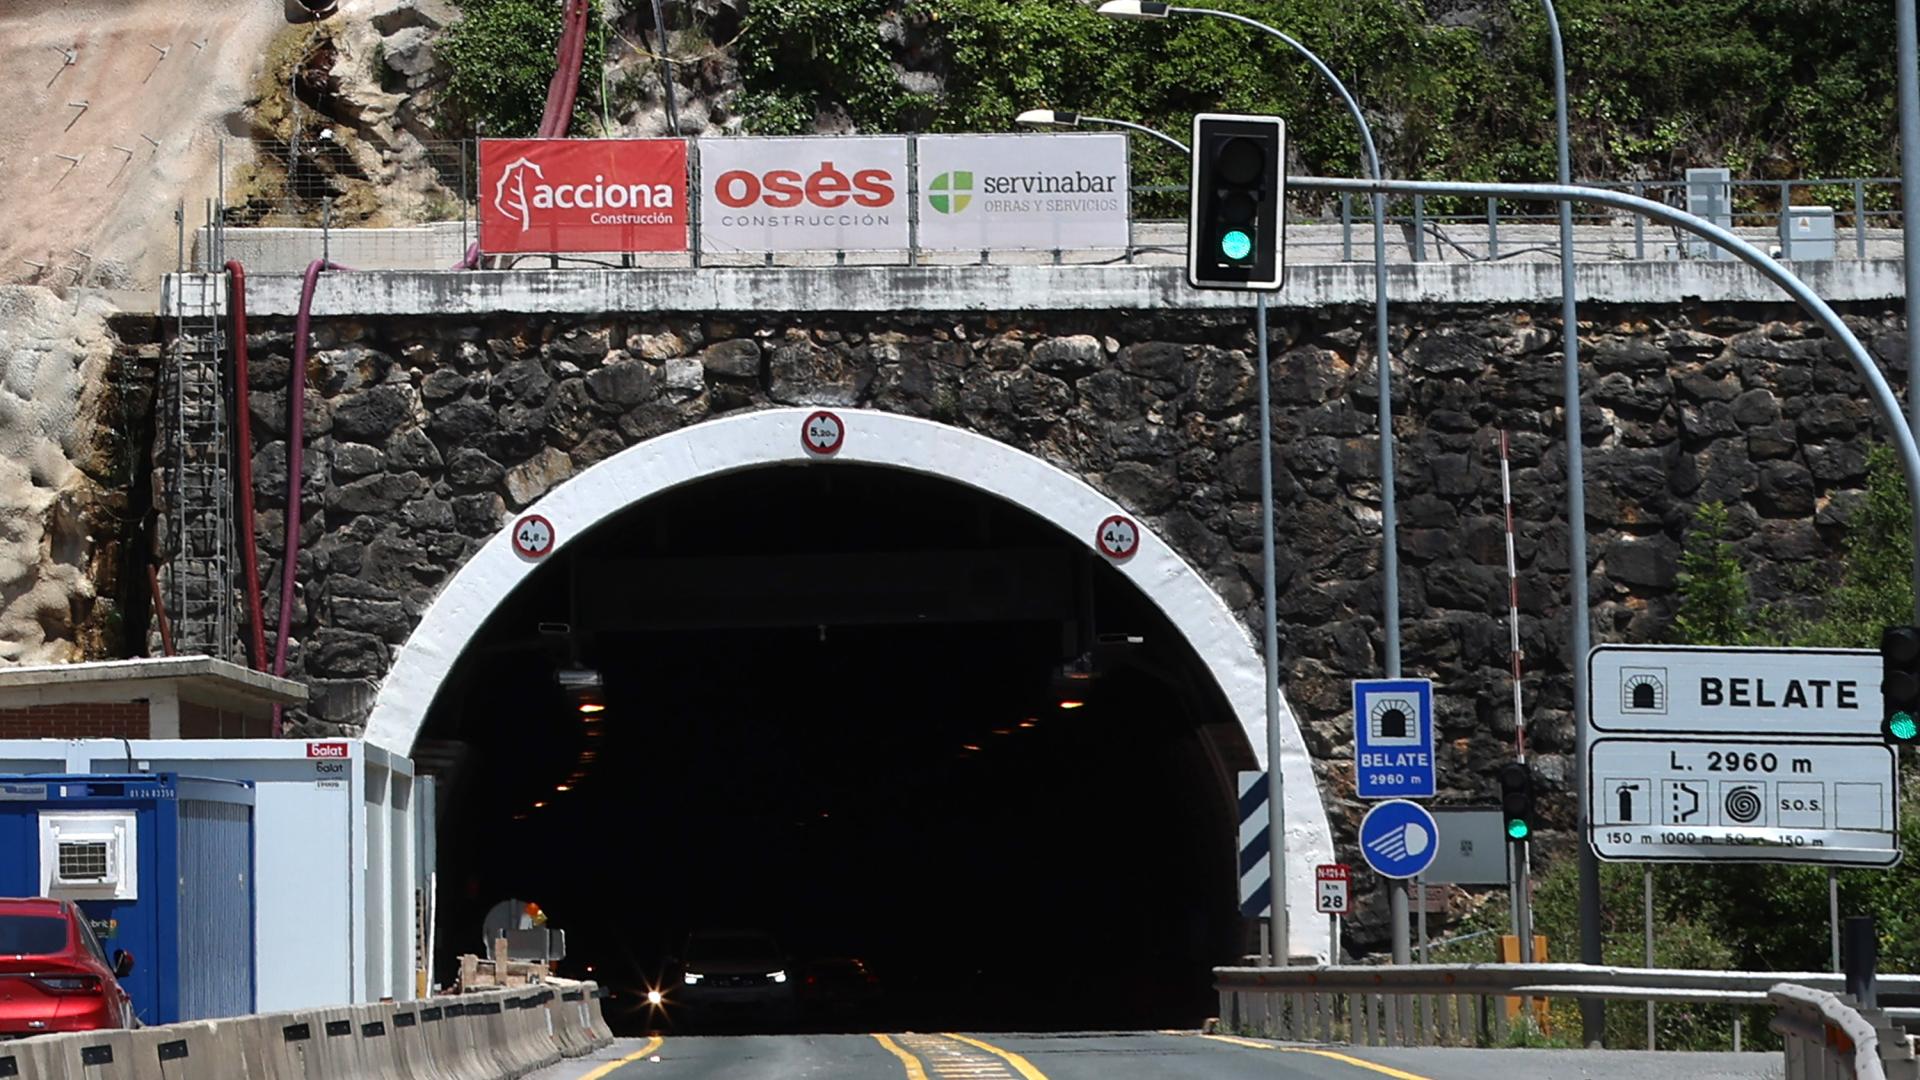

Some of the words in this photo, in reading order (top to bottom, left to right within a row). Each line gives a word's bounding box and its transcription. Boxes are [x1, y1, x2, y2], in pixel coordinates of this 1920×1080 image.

[984, 171, 1117, 193] servinabar
[532, 174, 673, 208] acciona
[984, 200, 1030, 212] OBRAS
[1033, 200, 1042, 212] Y
[1046, 199, 1118, 211] SERVICIOS
[590, 212, 673, 224] Construcción
[721, 213, 889, 227] CONSTRUCCIÓN
[1701, 677, 1859, 709] BELATE
[1361, 752, 1429, 768] BELATE
[1670, 751, 1693, 771] L.
[1707, 751, 1778, 773] 2960
[1792, 757, 1812, 773] m
[1369, 774, 1404, 785] 2960
[1410, 776, 1421, 785] m
[1606, 832, 1632, 844] 150
[1640, 835, 1652, 844] m
[1660, 832, 1696, 845] 1000
[1322, 895, 1343, 908] 28
